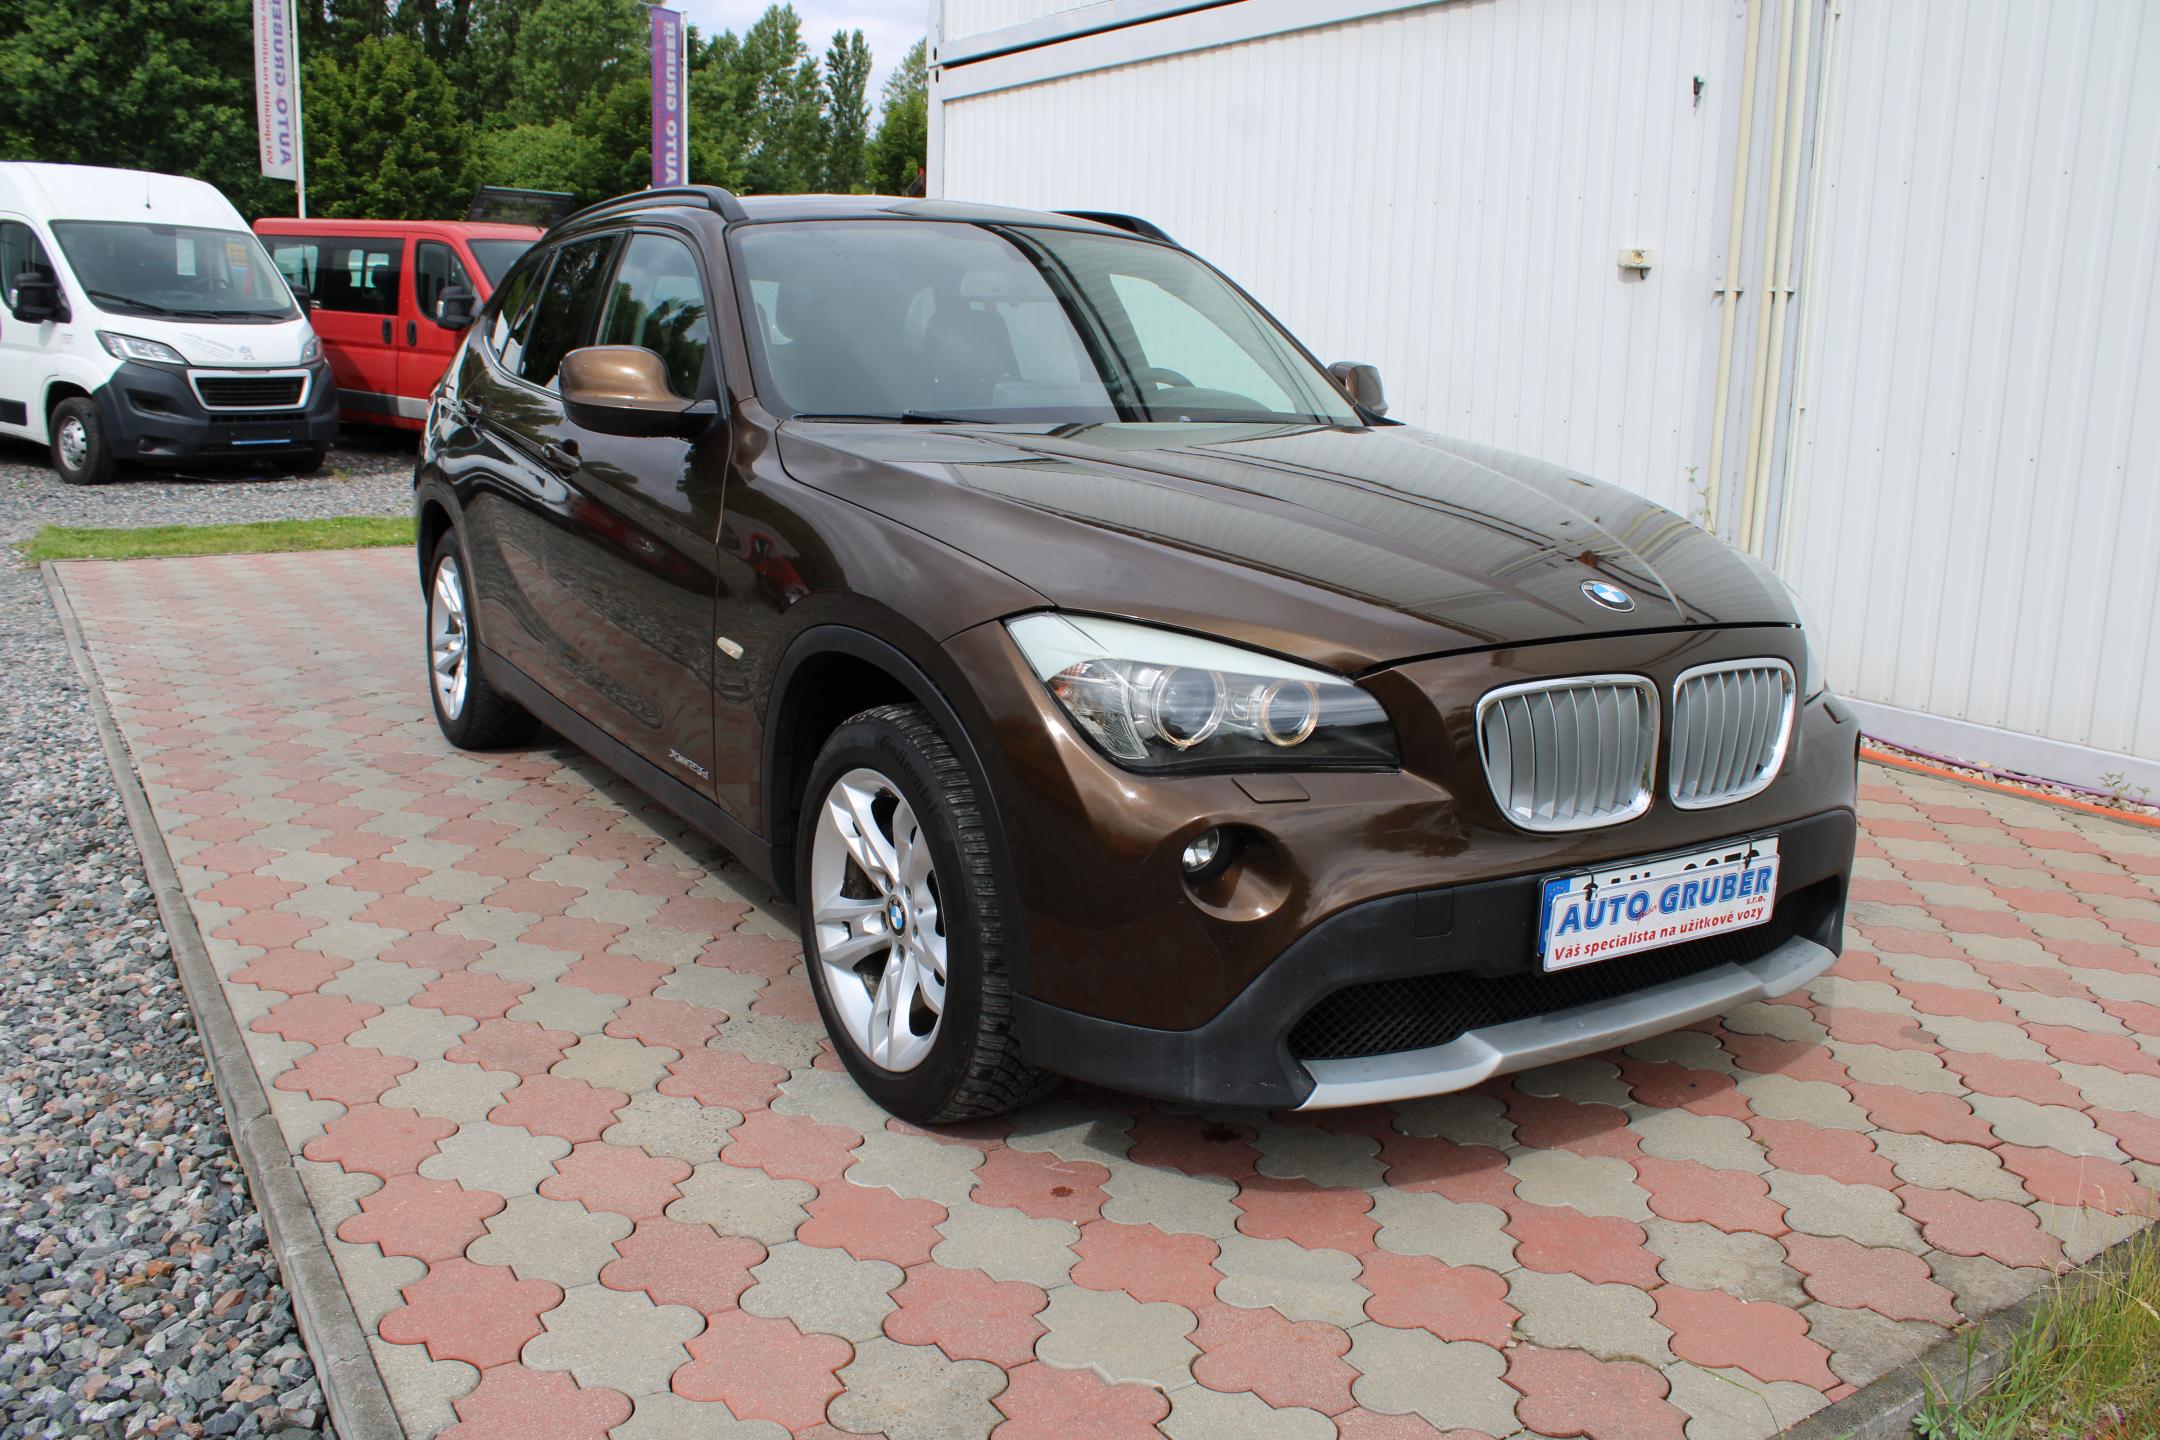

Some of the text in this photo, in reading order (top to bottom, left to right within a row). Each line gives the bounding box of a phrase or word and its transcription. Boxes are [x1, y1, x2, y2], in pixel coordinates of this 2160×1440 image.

[1555, 890, 1651, 937] AUTO
[1658, 865, 1773, 915] GRUBER
[1746, 895, 1766, 905] s.r.o.
[1555, 906, 1764, 961] Váš specialista na užitkové vozy
